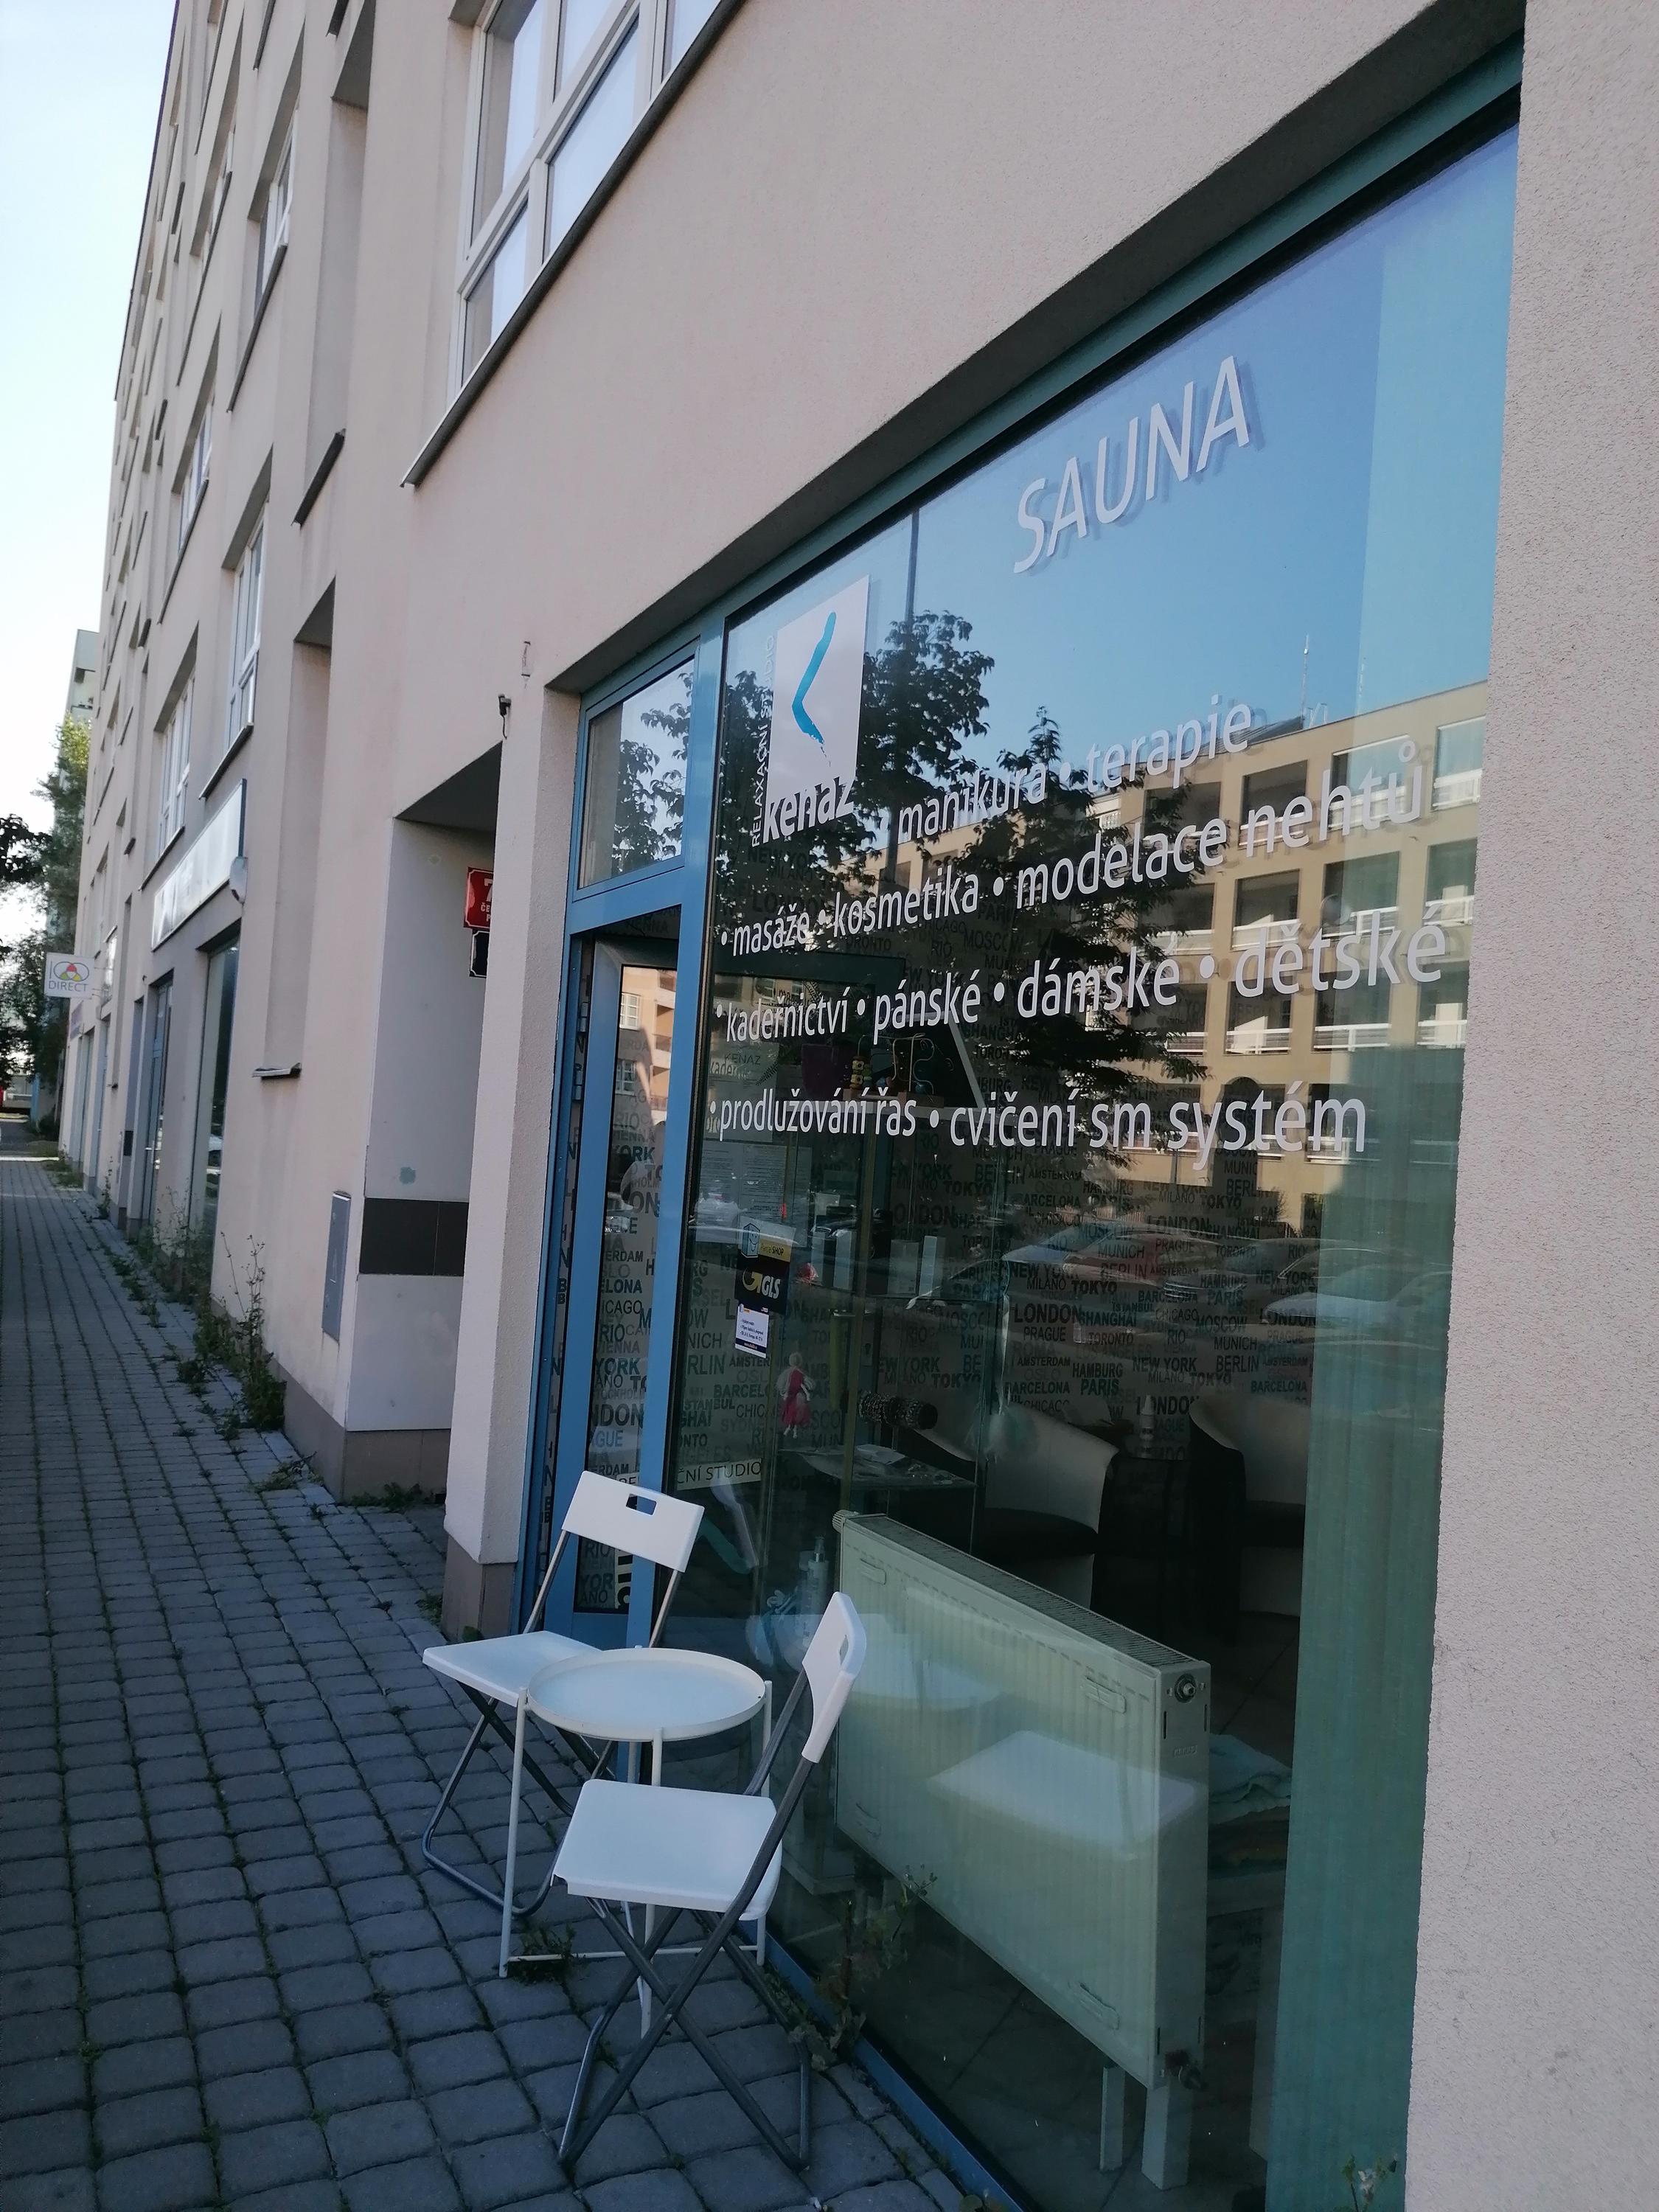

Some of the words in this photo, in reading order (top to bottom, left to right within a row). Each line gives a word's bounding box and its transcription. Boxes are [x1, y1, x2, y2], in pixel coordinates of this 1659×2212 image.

[1014, 355, 1249, 573] SAUNA
[898, 762, 1046, 845] manikura
[1086, 694, 1253, 792] terapie
[751, 724, 768, 847] RELAXAČNÍ
[762, 776, 854, 844] kenaz
[733, 902, 810, 957] masáže
[833, 866, 978, 938] kosmetika
[1017, 818, 1227, 909] modelace
[1246, 740, 1422, 858] nehtů
[923, 919, 966, 933] HICAGO
[846, 936, 891, 952] ORONTO
[931, 940, 952, 957] RIO
[726, 987, 850, 1043] kadeřnictví
[873, 970, 981, 1044] pánské
[1018, 932, 1180, 1018] dámské
[1235, 905, 1446, 998] dětské
[49, 981, 88, 992] DIRECT
[725, 1054, 761, 1065] KENAZ
[719, 1087, 869, 1141] prodlužování
[875, 1087, 917, 1137] řas
[950, 1088, 1081, 1148] cvičení
[1089, 1099, 1151, 1149] sm
[1166, 1080, 1366, 1171] systém
[1224, 1159, 1258, 1175] MUNIC
[1021, 1194, 1080, 1208] ARCELONA
[1158, 1192, 1195, 1204] MILANO
[1200, 1194, 1242, 1210] TOKYO
[894, 1203, 955, 1224] ODON
[606, 1251, 644, 1262] ERDAM
[1098, 1244, 1145, 1259] MUNICH
[602, 1264, 631, 1278] SLO
[1011, 1262, 1042, 1277] NEW
[600, 1279, 642, 1293] ELONA
[762, 1275, 782, 1299] GLS
[1026, 1278, 1067, 1291] MILANO
[1071, 1280, 1118, 1295] TOKYO
[1138, 1290, 1198, 1303] BARCONA
[602, 1300, 642, 1315] ICAGO
[1014, 1303, 1082, 1323] LONDON
[938, 1311, 985, 1331] MOSCO
[1079, 1311, 1138, 1326] SHANGHAI
[1155, 1308, 1198, 1322] CHICAGO
[1195, 1315, 1248, 1333] MOSCOW
[599, 1324, 625, 1343] RIO
[686, 1332, 723, 1349] NICH
[1023, 1326, 1066, 1341] PRAGUE
[1088, 1332, 1134, 1346] TORONTO
[1168, 1329, 1186, 1345] RIO
[597, 1340, 640, 1354] IENNA
[1214, 1336, 1258, 1351] MUNICH
[596, 1357, 641, 1375] YORK
[687, 1354, 726, 1375] RLIN
[728, 1356, 770, 1368] AMSTER
[903, 1357, 941, 1374] YORK
[1018, 1356, 1071, 1366] AMSTERDAM
[1133, 1357, 1161, 1371] NEW
[1164, 1357, 1198, 1372] YORK
[1216, 1355, 1259, 1373] BERLIN
[737, 1370, 768, 1383] OSL
[1072, 1362, 1124, 1378] HAMBURG
[1148, 1371, 1185, 1384] MILANO
[1190, 1371, 1232, 1385] TOKYO
[595, 1374, 623, 1388] ANO
[884, 1372, 926, 1385] MINO
[1251, 1380, 1307, 1393] BARCELONA
[714, 1384, 768, 1398] BARCEL
[1081, 1378, 1121, 1396] PARIS
[684, 1399, 735, 1411] STANBUL
[737, 1404, 768, 1418] CHIC
[1025, 1399, 1069, 1413] CHICAG
[1136, 1395, 1200, 1416] LNDO
[591, 1403, 644, 1427] NDON
[592, 1430, 623, 1448] GUE
[680, 1433, 708, 1447] ONTO
[591, 1464, 629, 1475] ERDAM
[677, 1464, 701, 1484] ČNÍ
[706, 1461, 762, 1481] STUDIO
[585, 1541, 610, 1558] RIO
[580, 1573, 613, 1590] YOR
[582, 1590, 608, 1604] ANO
